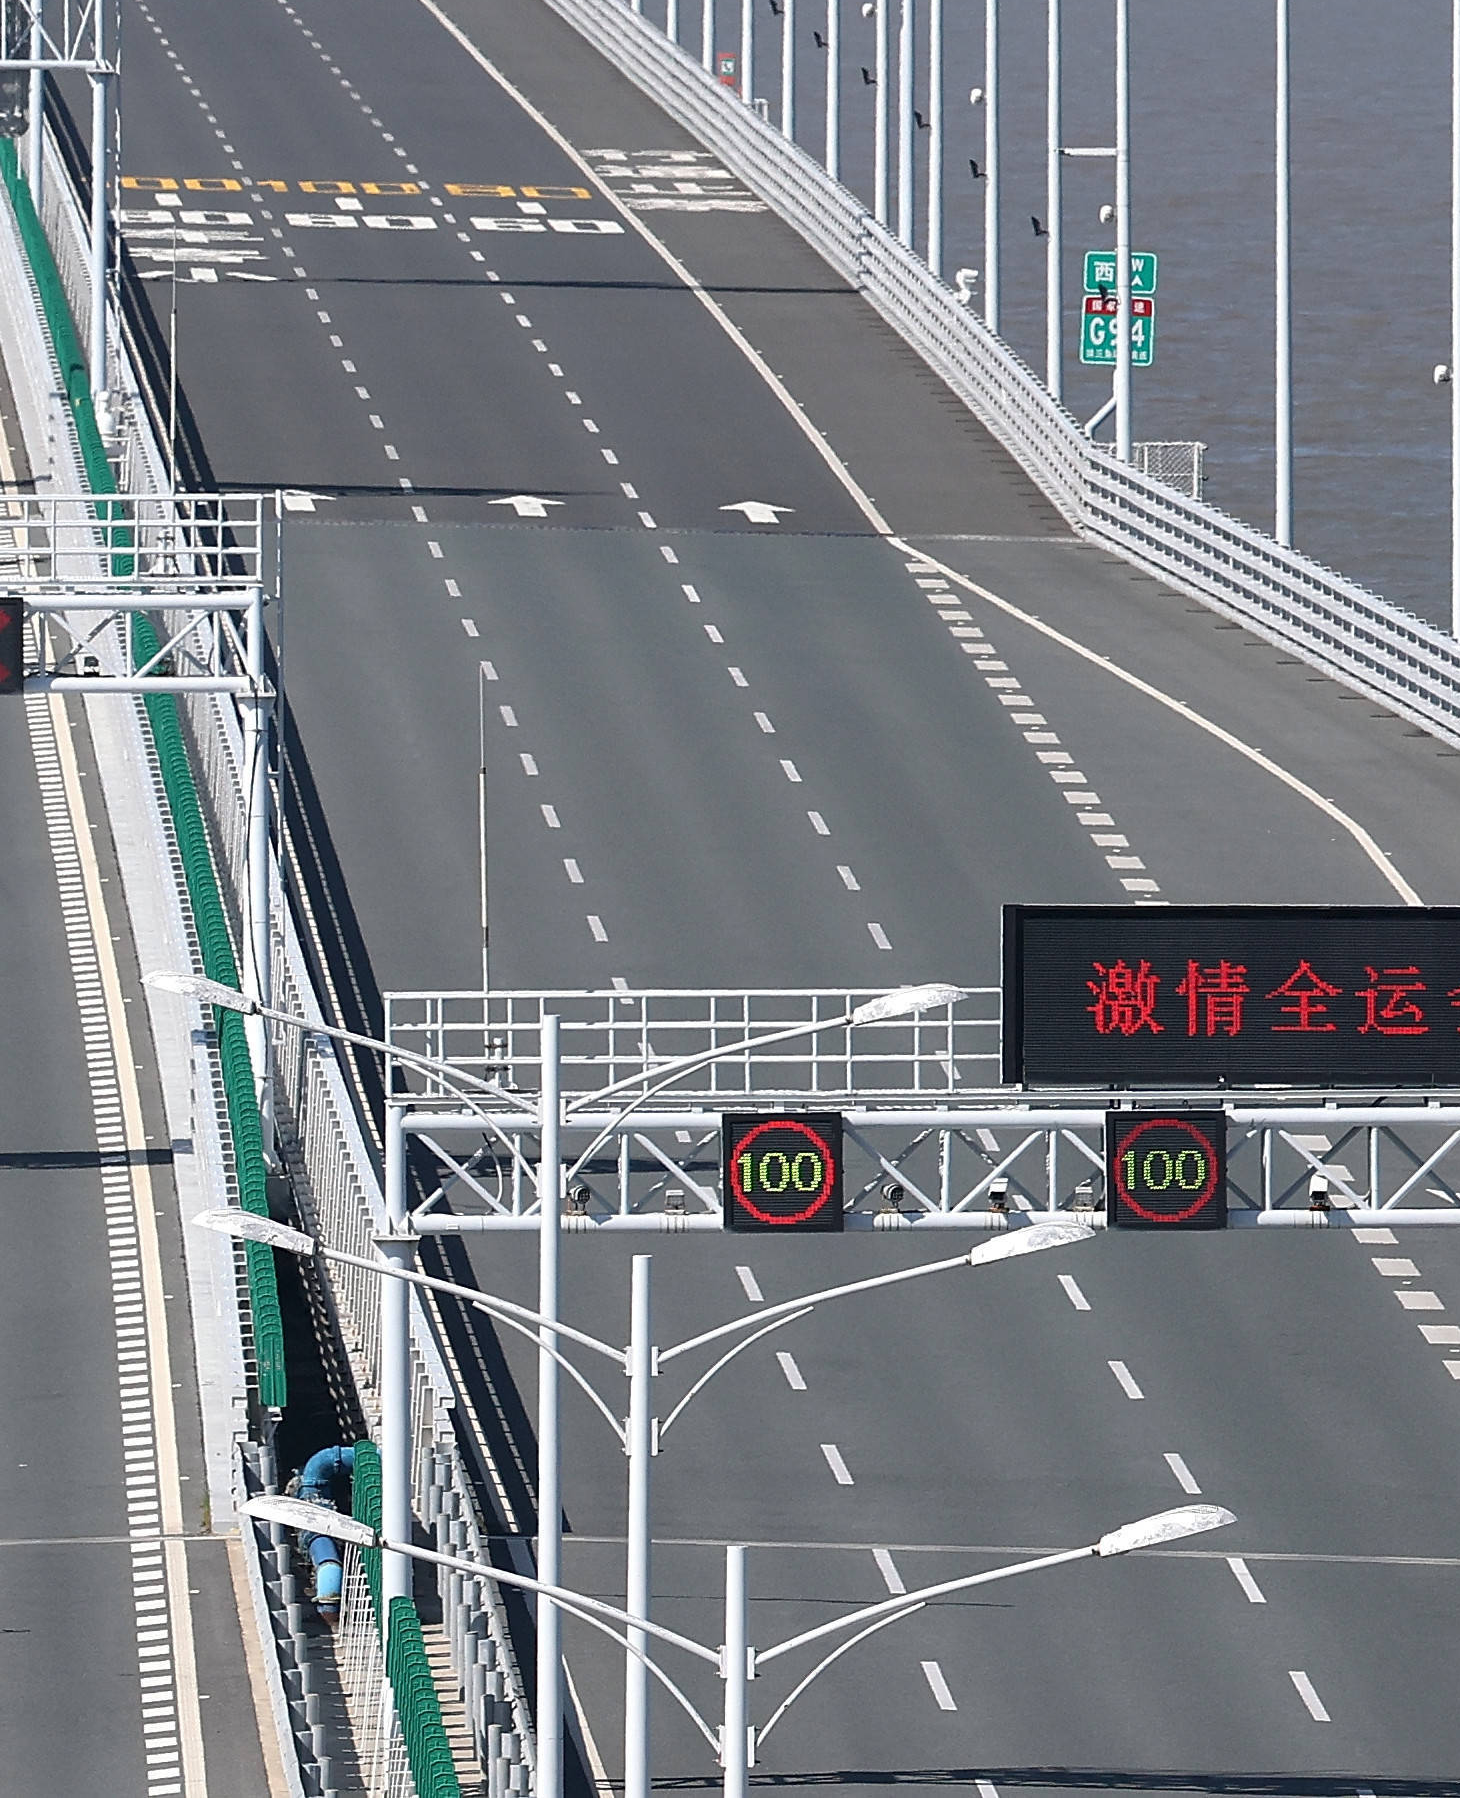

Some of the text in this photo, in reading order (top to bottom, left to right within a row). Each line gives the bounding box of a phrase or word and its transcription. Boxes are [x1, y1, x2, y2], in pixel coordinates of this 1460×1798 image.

[1093, 261, 1116, 282] 西
[737, 1152, 822, 1192] 100
[1121, 1150, 1205, 1190] 100
